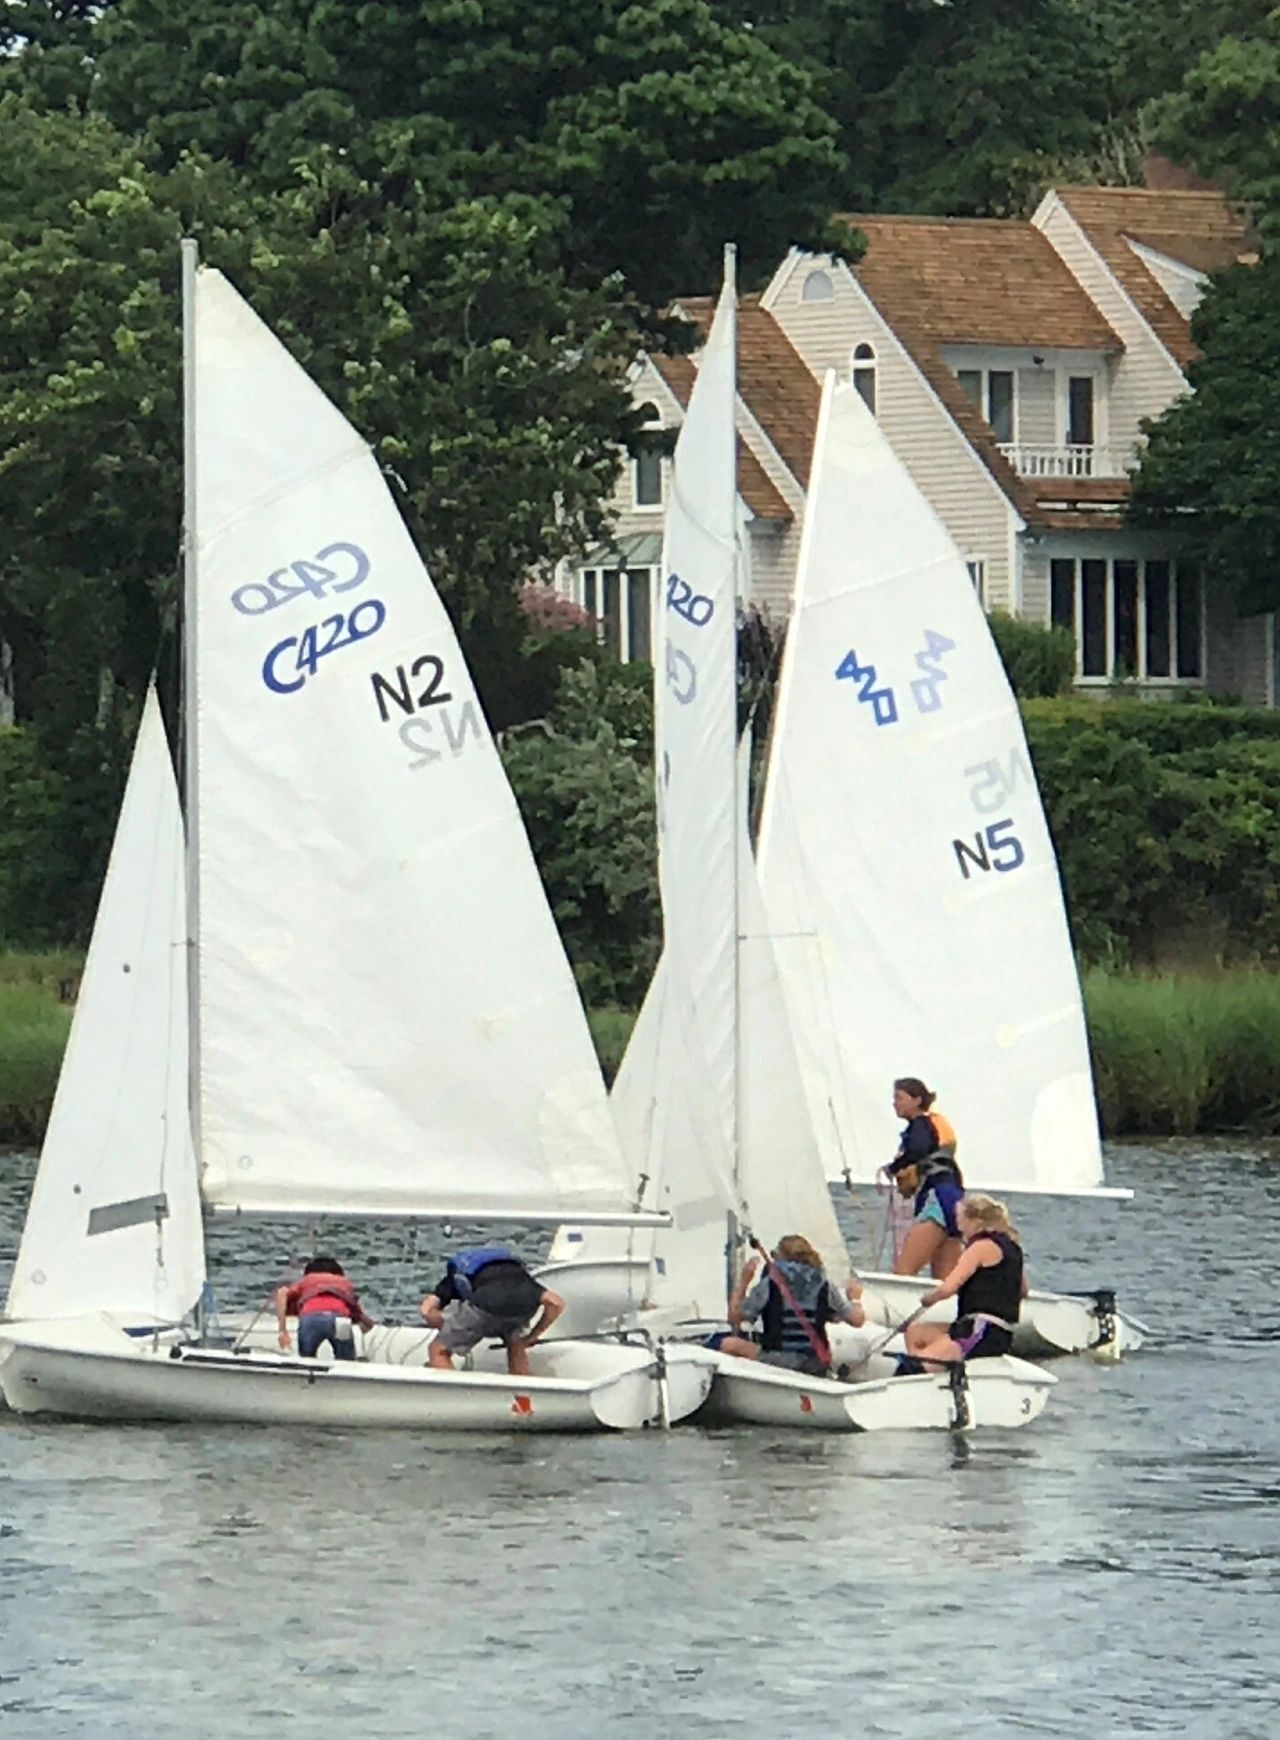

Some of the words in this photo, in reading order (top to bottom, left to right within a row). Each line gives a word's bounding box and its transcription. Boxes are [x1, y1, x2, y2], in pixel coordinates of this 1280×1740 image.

[261, 599, 386, 694] C420
[370, 654, 453, 722] N2
[835, 649, 899, 726] 420
[952, 817, 1026, 880] N5
[1021, 1397, 1032, 1415] 3
